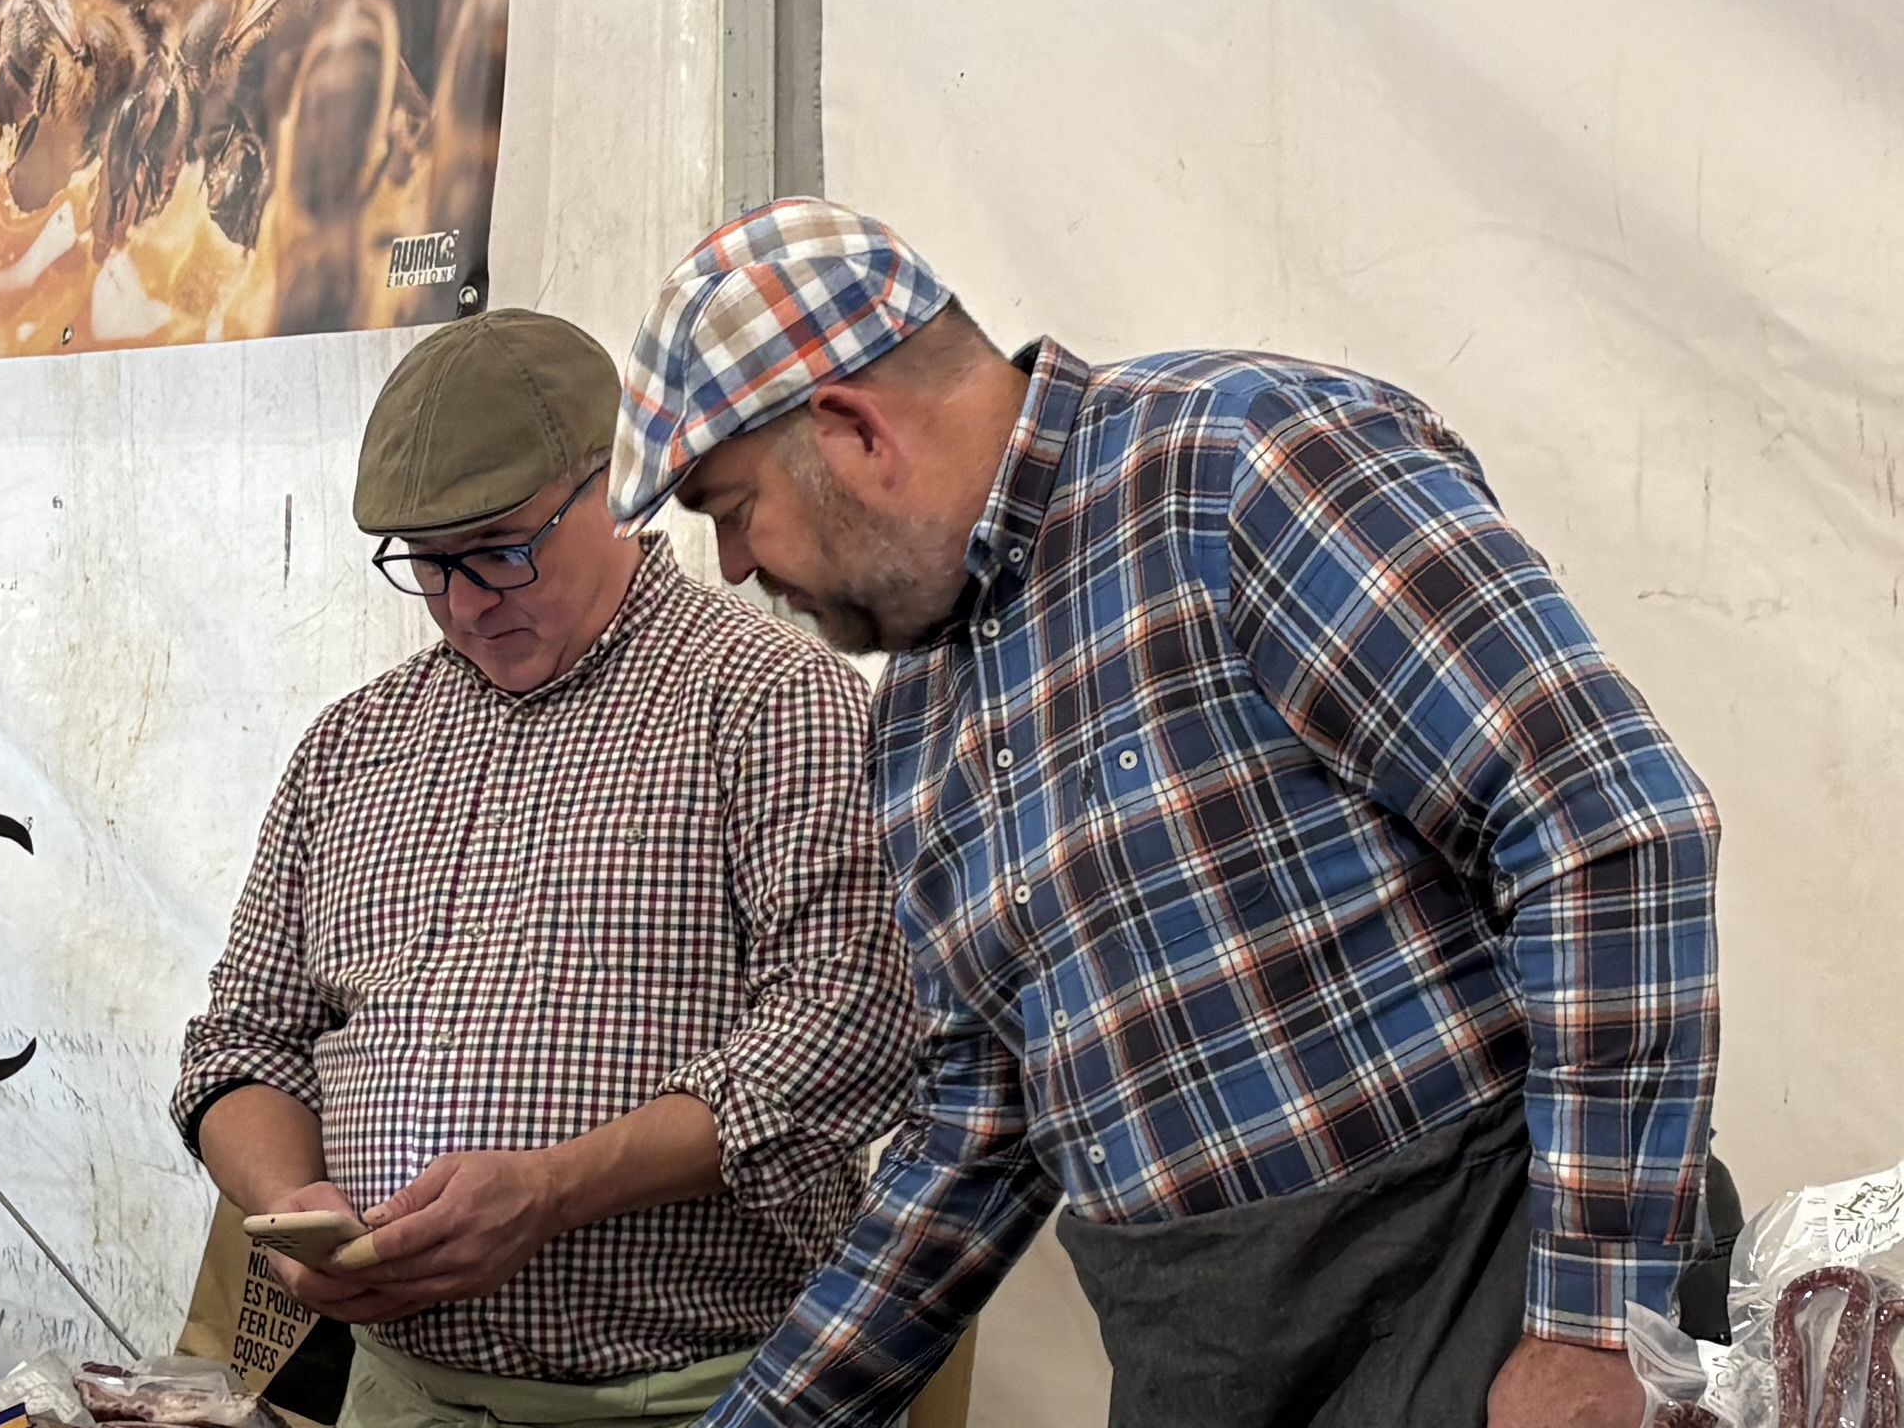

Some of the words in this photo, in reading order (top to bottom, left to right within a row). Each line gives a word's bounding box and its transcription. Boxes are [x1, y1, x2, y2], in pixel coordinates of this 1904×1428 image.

[1835, 1222, 1864, 1253] Cal
[244, 1278, 264, 1307] ES
[238, 1306, 267, 1340] FER
[269, 1316, 296, 1349] LES
[233, 1335, 278, 1373] COSES
